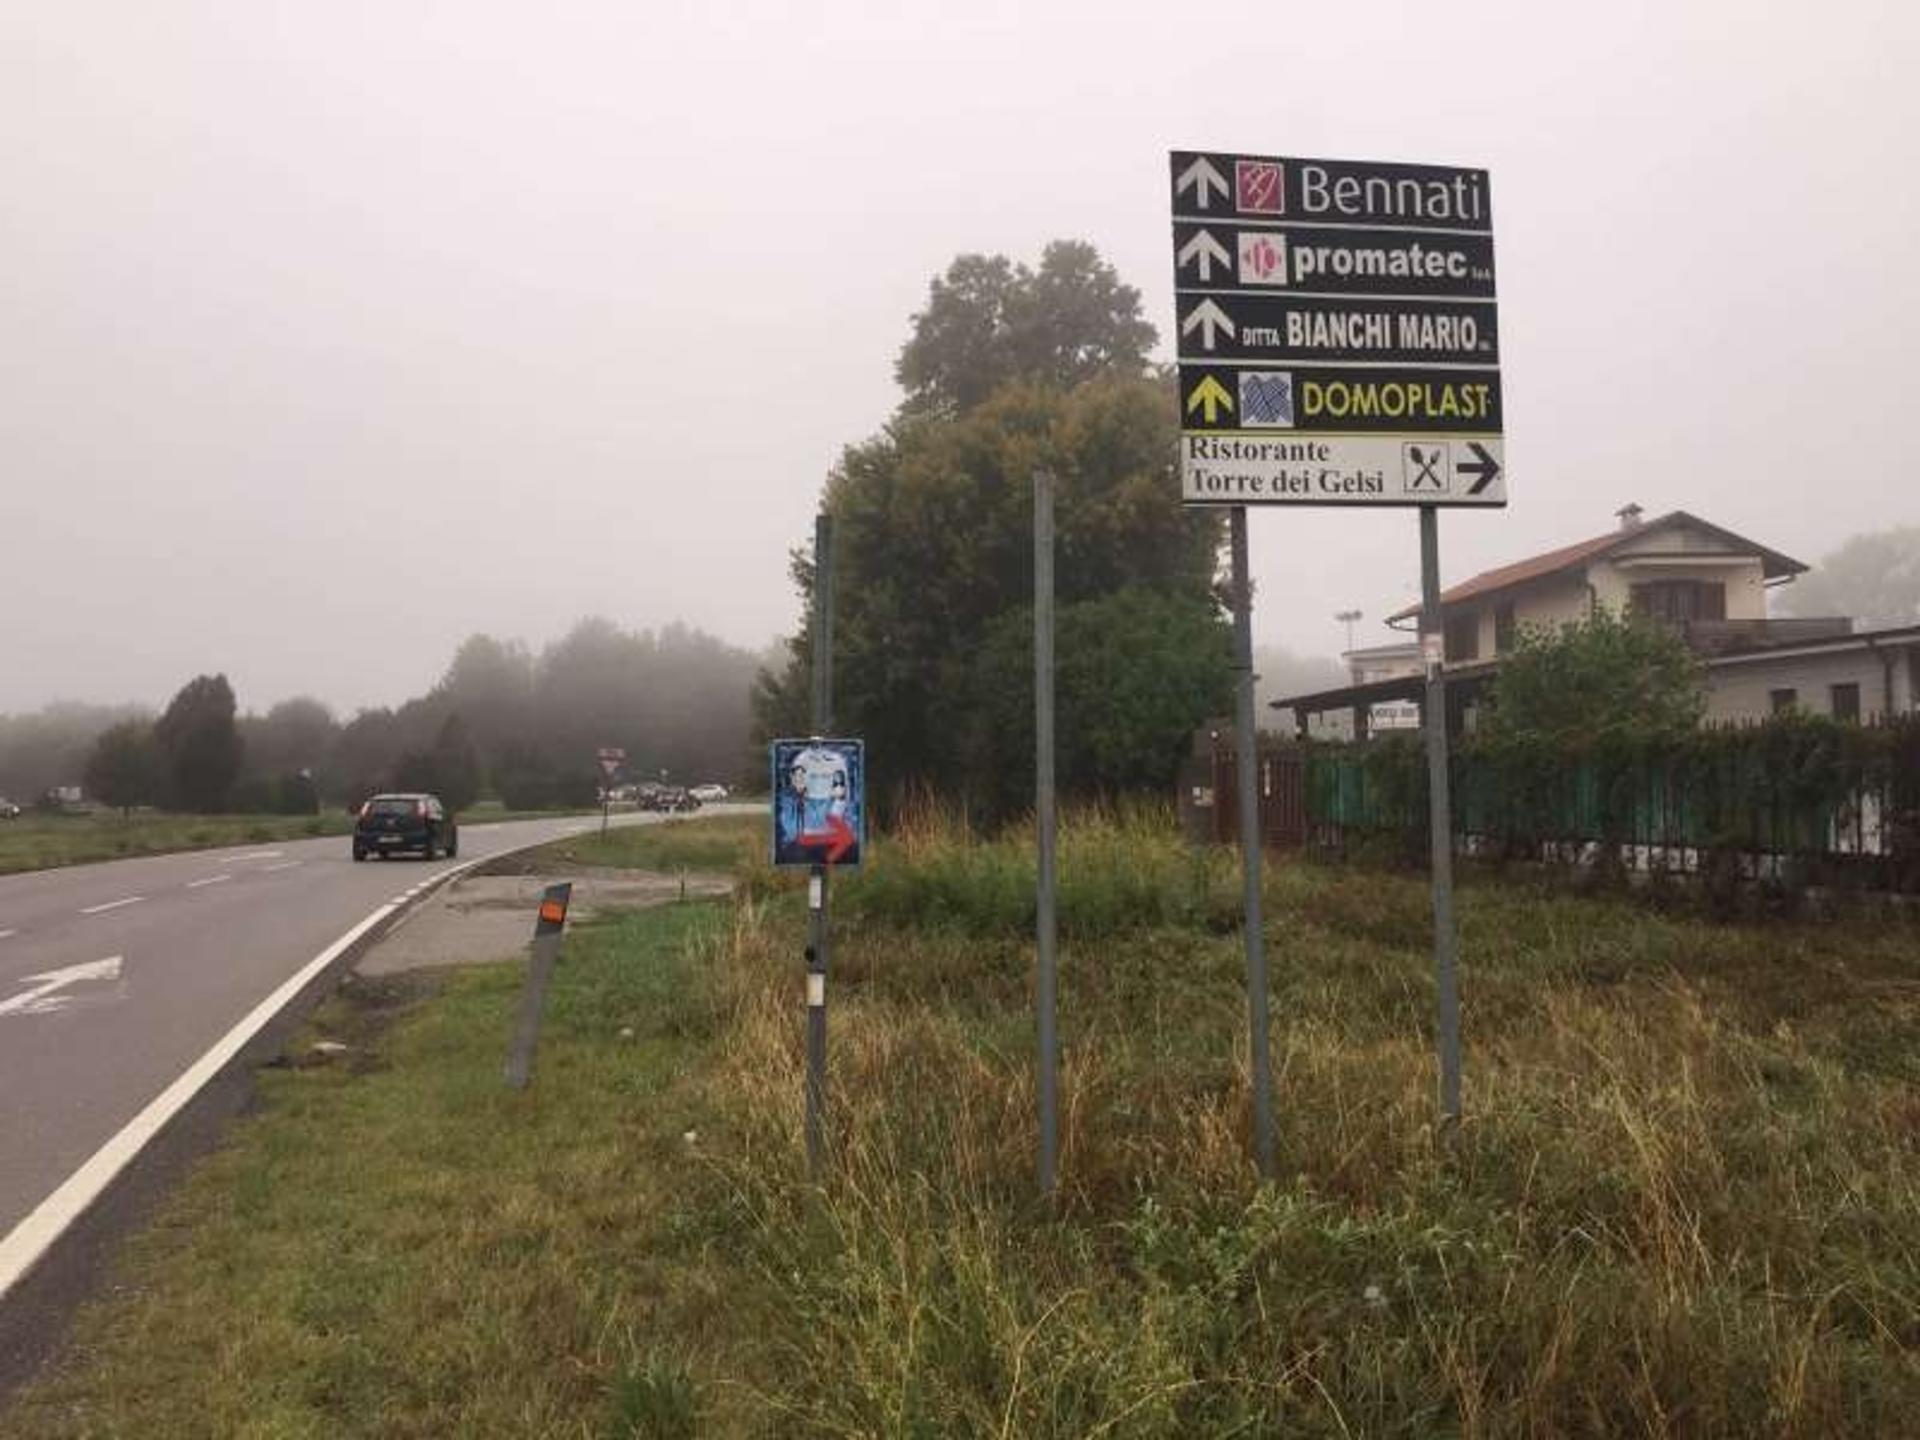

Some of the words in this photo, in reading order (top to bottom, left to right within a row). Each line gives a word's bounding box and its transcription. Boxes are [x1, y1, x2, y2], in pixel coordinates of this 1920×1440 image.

[1302, 166, 1480, 220] Bennati
[1293, 243, 1467, 282] promatec
[1242, 328, 1280, 346] DITTA
[1286, 312, 1391, 349] BIANCHI
[1398, 314, 1477, 351] MARIO
[1302, 381, 1489, 417] DOMOPLAST
[1189, 438, 1330, 462] Ristorante
[1189, 469, 1264, 492] Torre
[1271, 470, 1309, 493] dei
[1319, 470, 1384, 493] Gelsi
